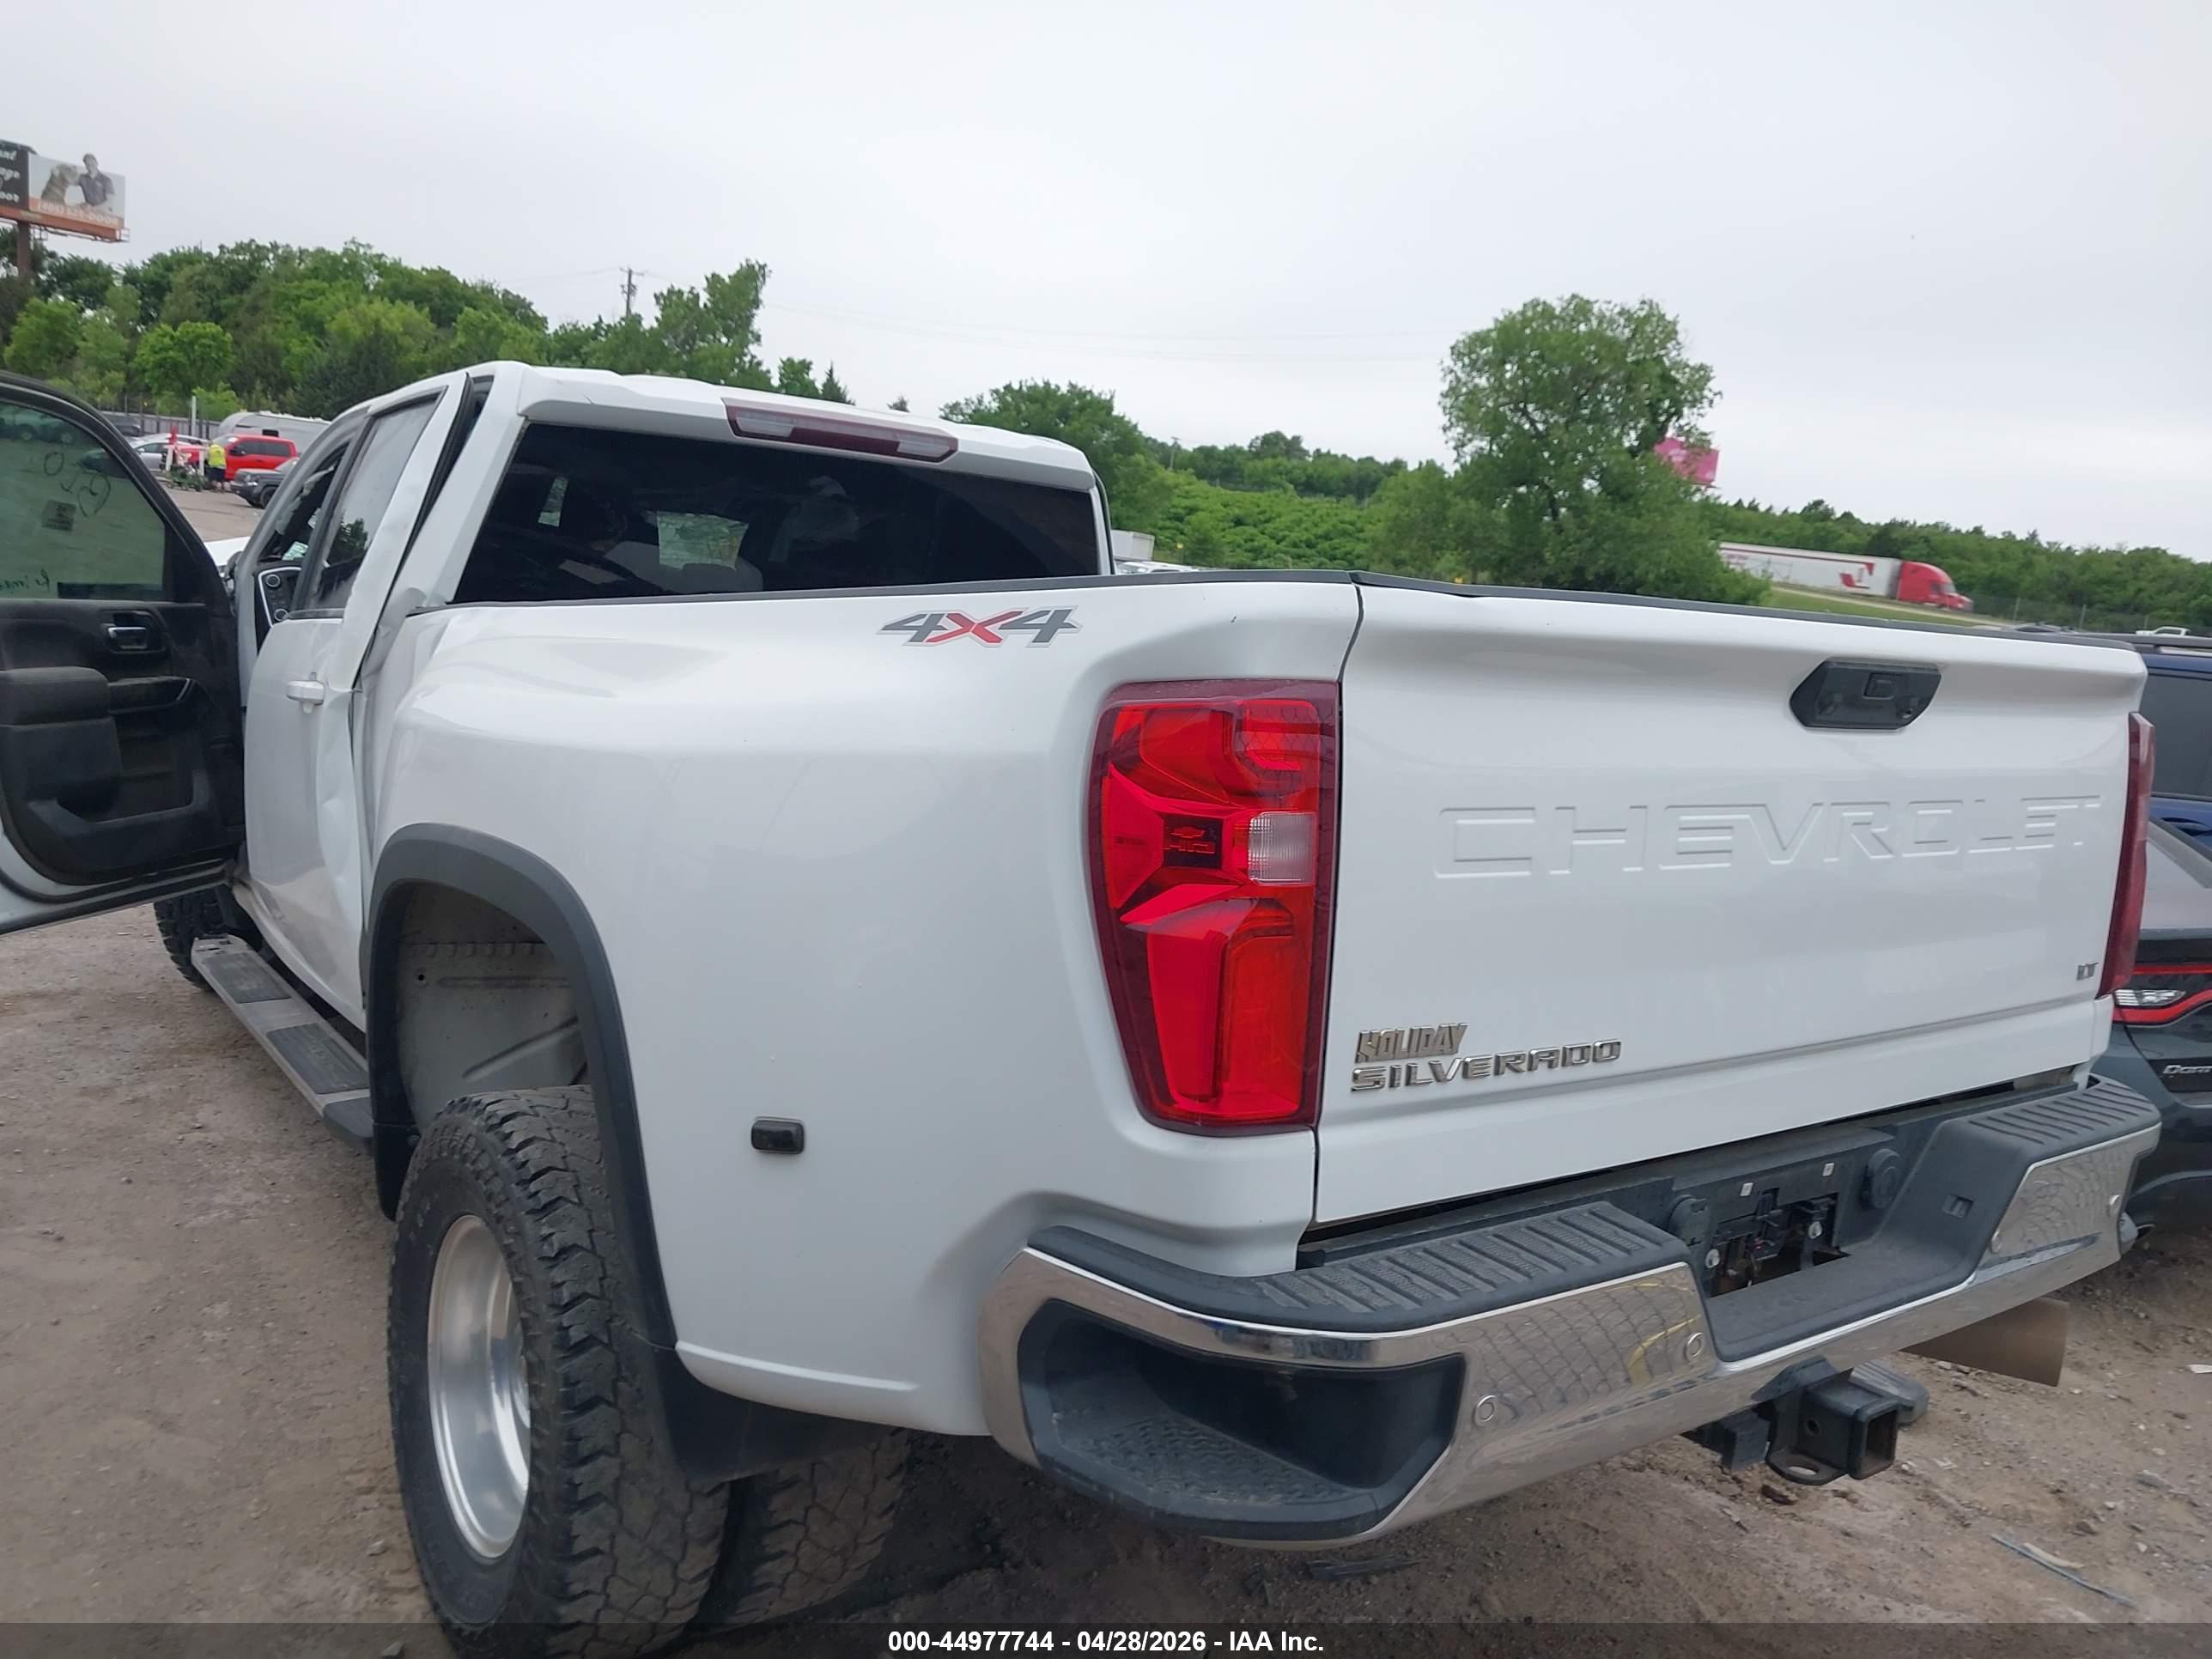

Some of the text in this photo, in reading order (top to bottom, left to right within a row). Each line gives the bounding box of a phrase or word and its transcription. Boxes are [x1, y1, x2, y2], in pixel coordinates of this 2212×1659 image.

[1434, 794, 2101, 878] CHEVROLET
[1351, 1038, 1622, 1092] SILVERADO
[1355, 1023, 1468, 1063] HOLIDAY
